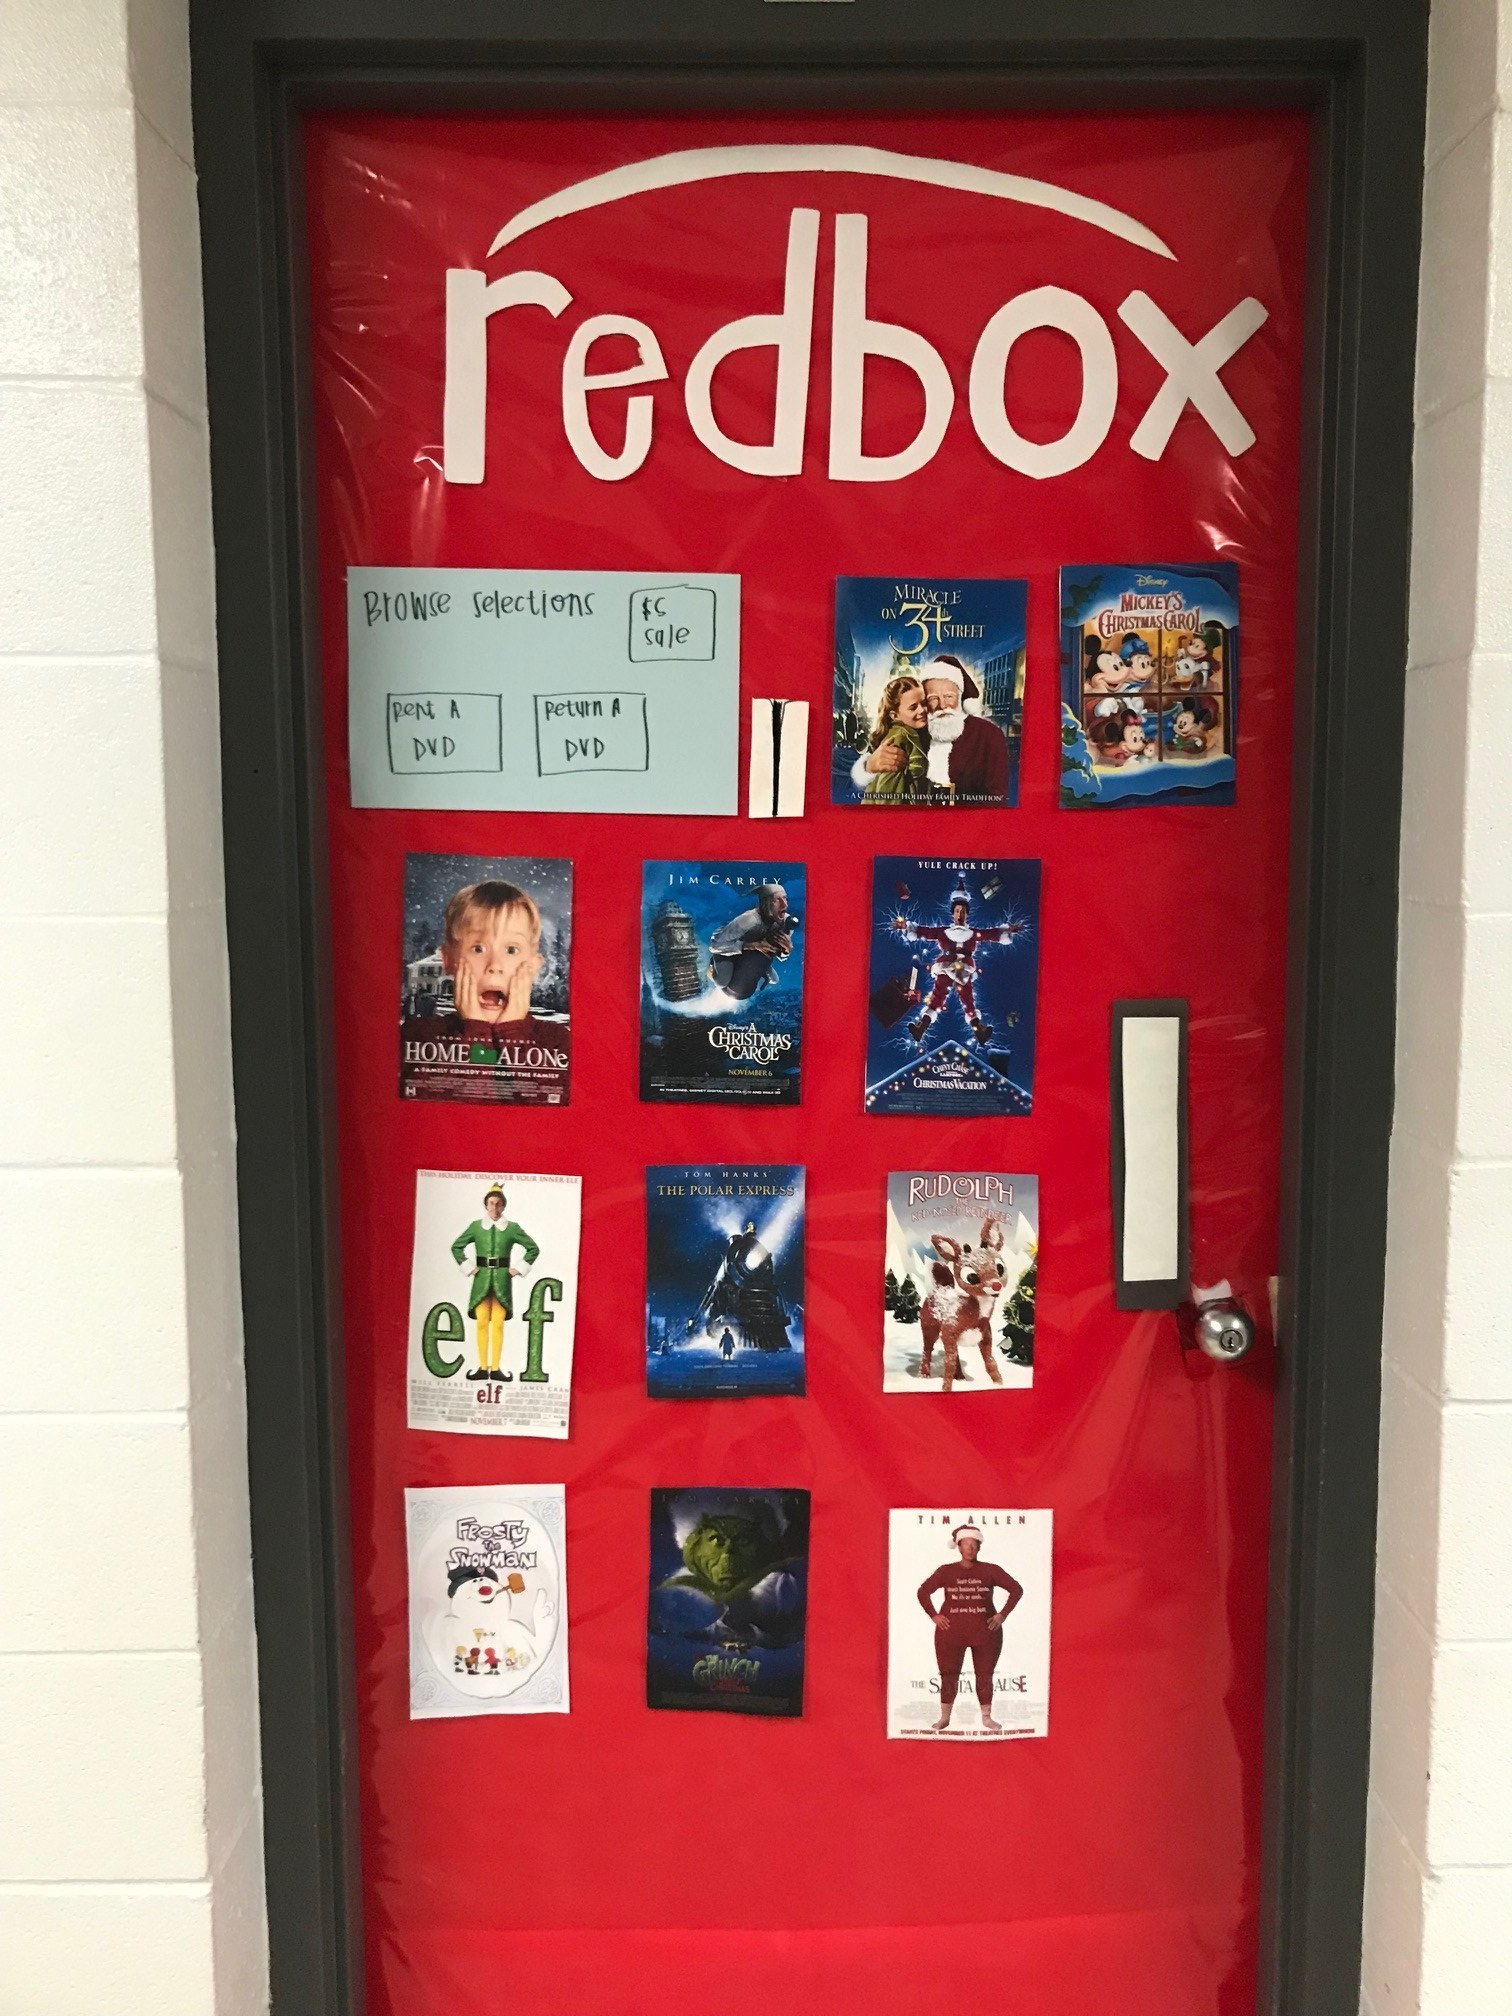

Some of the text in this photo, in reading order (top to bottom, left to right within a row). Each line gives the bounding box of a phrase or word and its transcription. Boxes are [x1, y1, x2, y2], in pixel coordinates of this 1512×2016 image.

[443, 207, 1270, 484] redbox
[473, 590, 594, 620] selections
[893, 583, 962, 607] MIRACLE
[1121, 592, 1184, 613] MICKEY'S
[881, 607, 897, 620] ON
[1098, 608, 1203, 639] CHRISTMAS CAROL
[644, 622, 690, 650] sale
[943, 624, 985, 639] STREET
[392, 698, 461, 721] Rent A
[544, 697, 622, 722] Return A
[413, 737, 456, 762] DVD
[566, 737, 605, 762] DVD
[901, 793, 934, 801] HOLIDAY
[918, 861, 998, 871] YULE CRACK UP!
[669, 873, 781, 887] JIM CARREY
[748, 1022, 758, 1033] A
[707, 1026, 792, 1053] CHRISTMAS
[404, 1041, 471, 1064] HOME
[728, 1046, 780, 1066] CAROL
[728, 1068, 768, 1077] NOVEMBER
[913, 1077, 987, 1091] CHRISTMAS VACATION
[474, 1173, 515, 1181] DISCOVER
[684, 1171, 712, 1179] TOM
[657, 1184, 796, 1197] THE POLAR EXPRESS
[907, 1173, 1014, 1207] RUDOLPH
[476, 1383, 504, 1405] elf
[918, 1514, 1027, 1525] TIM ALLEN
